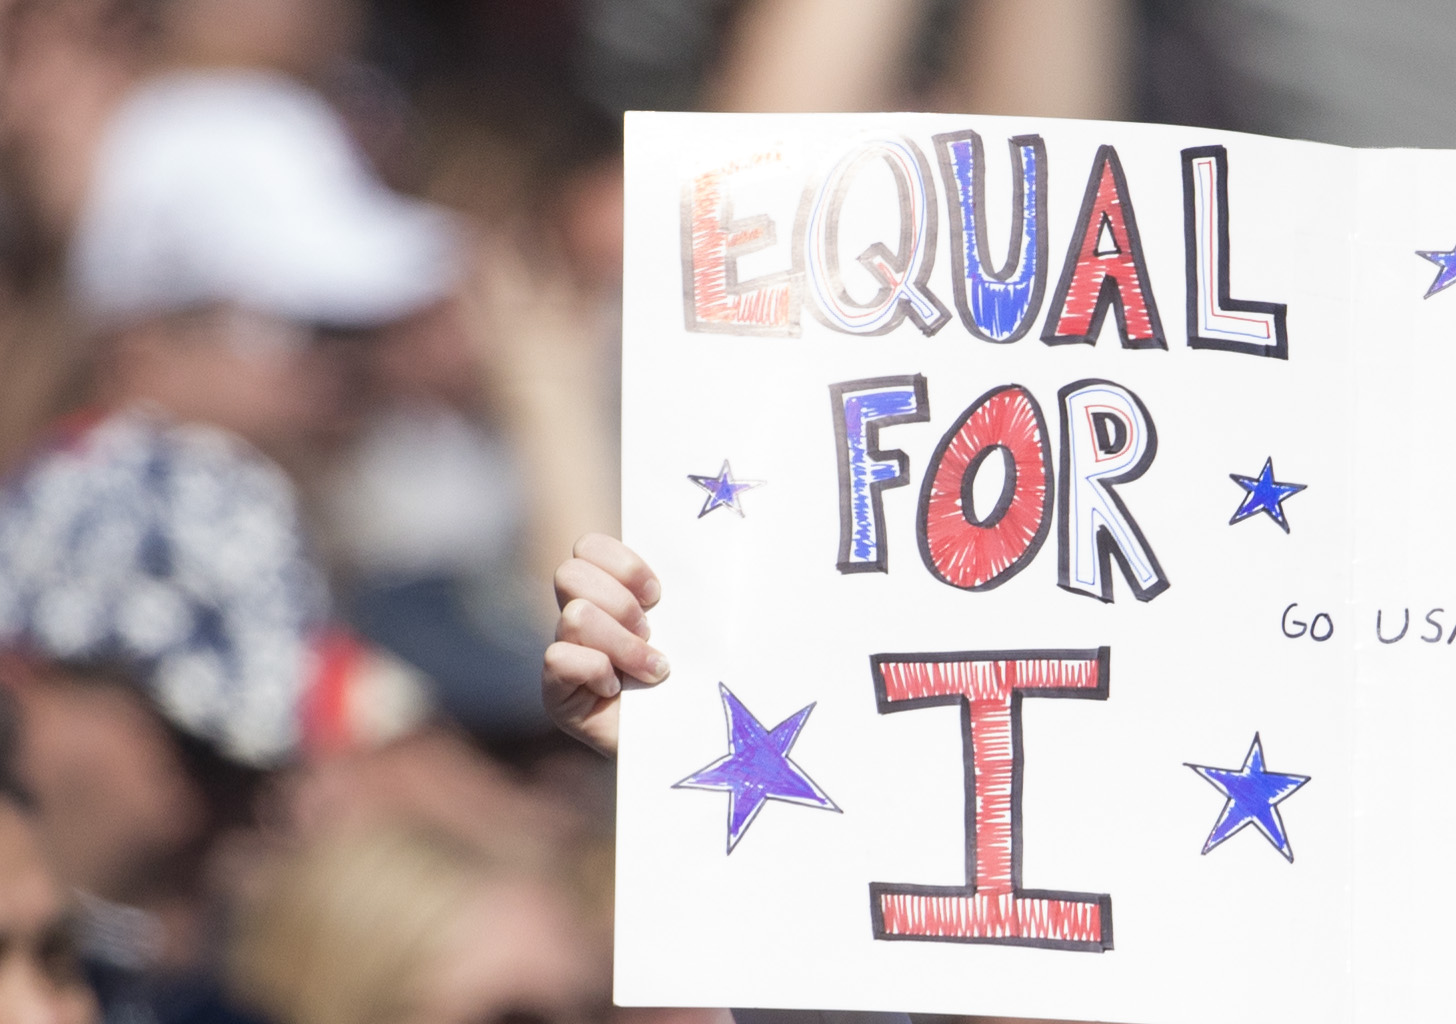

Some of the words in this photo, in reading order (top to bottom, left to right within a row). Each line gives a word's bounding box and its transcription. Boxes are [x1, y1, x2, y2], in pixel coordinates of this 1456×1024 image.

[681, 129, 1288, 360] EQUAL
[829, 373, 1170, 604] FOR
[1281, 602, 1334, 642] GO
[869, 646, 1114, 952] I
